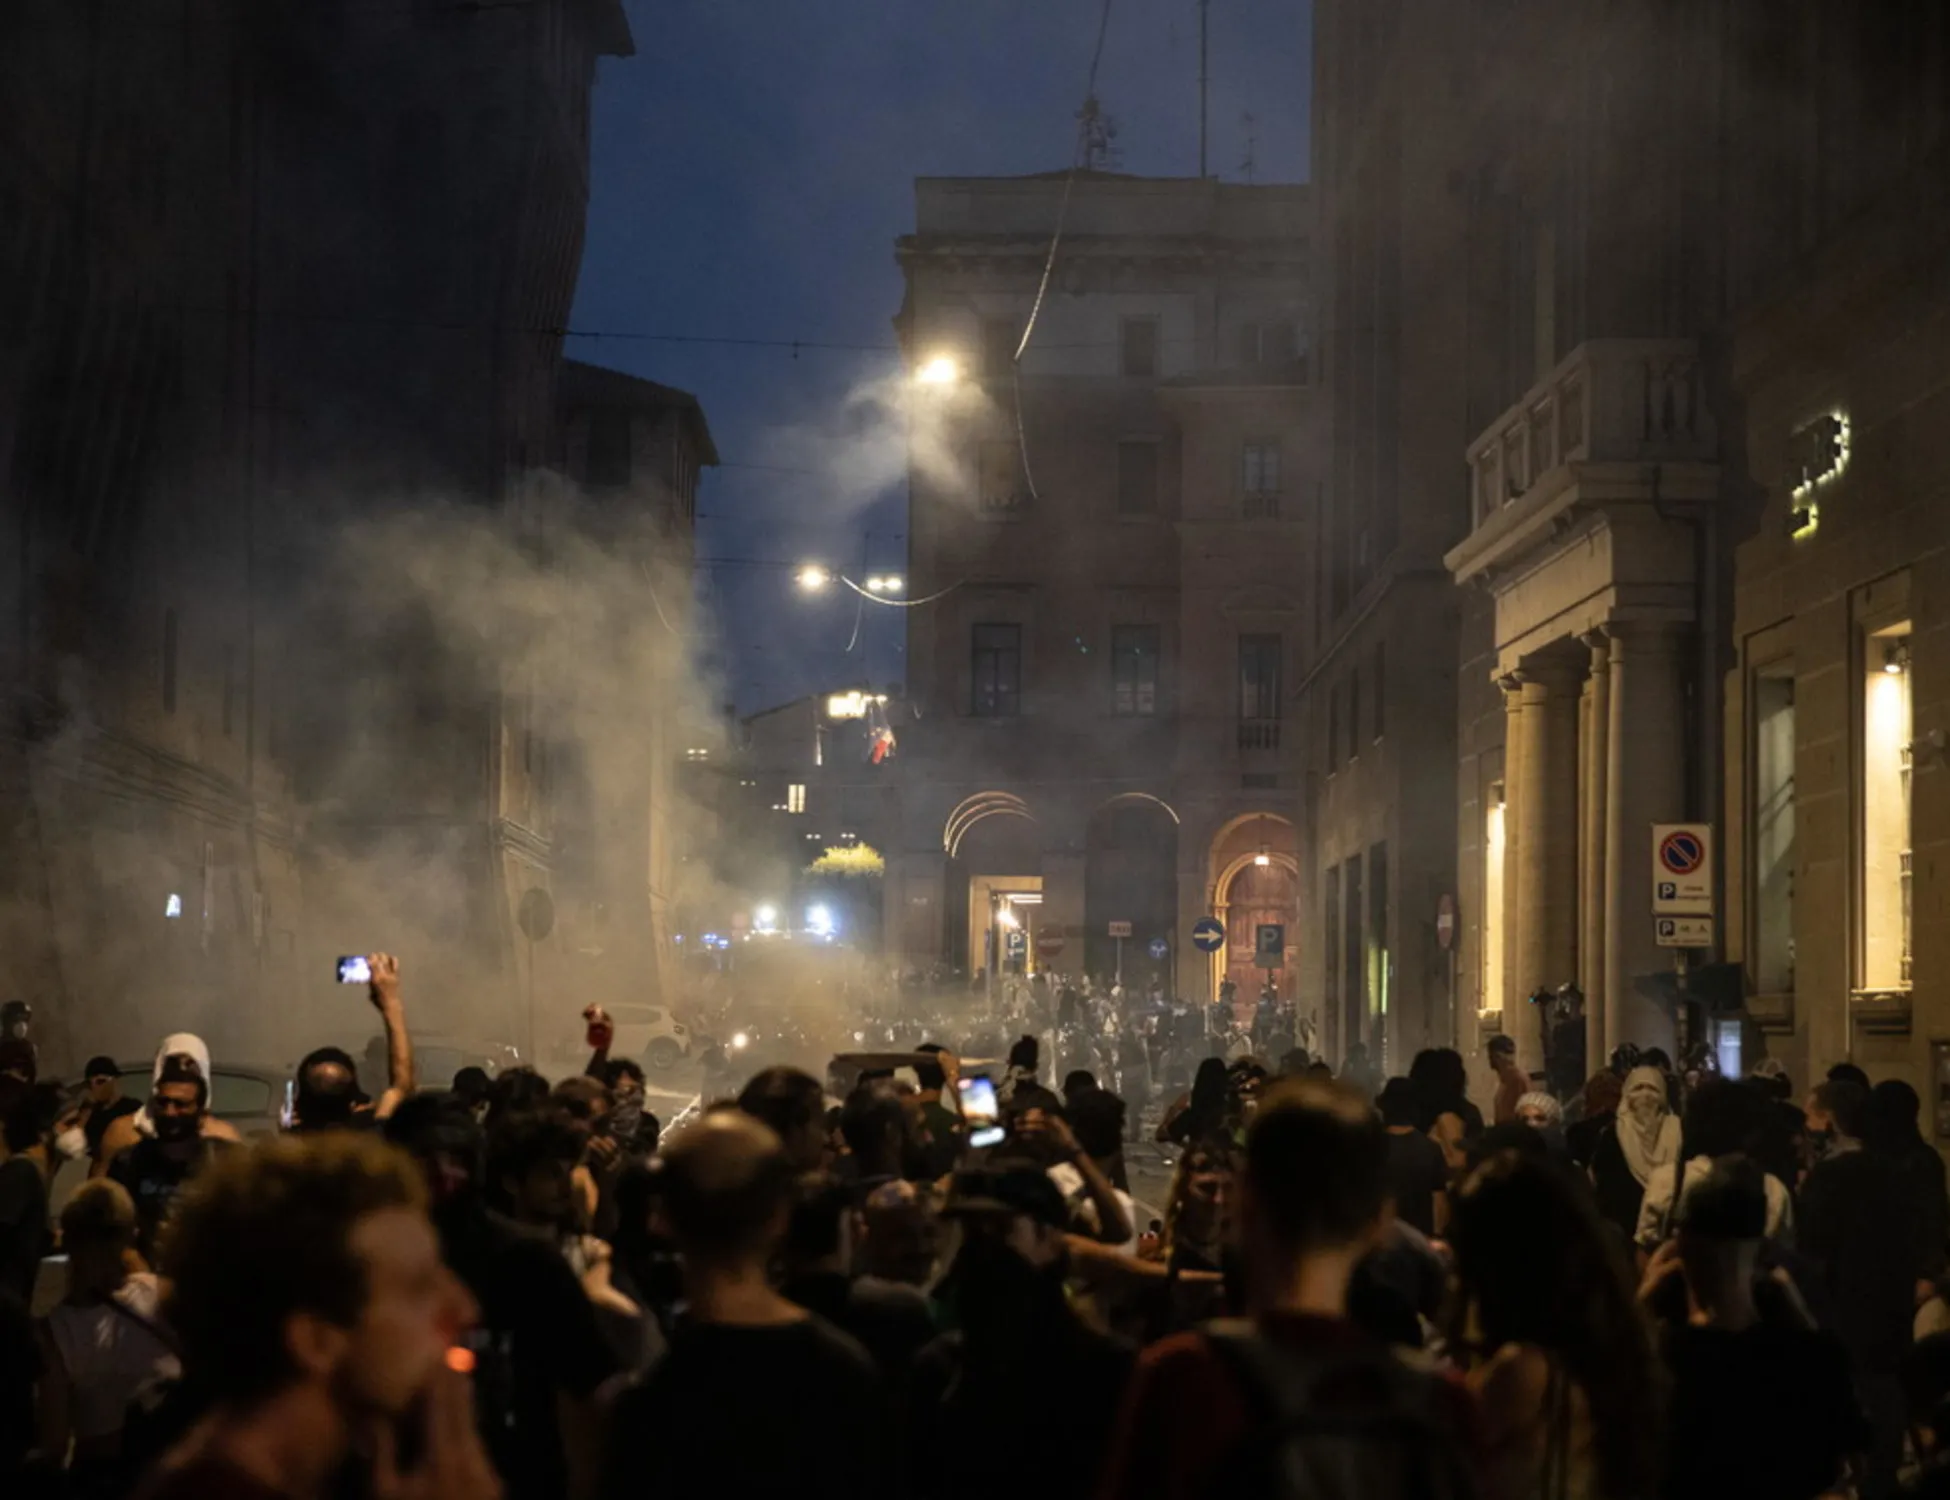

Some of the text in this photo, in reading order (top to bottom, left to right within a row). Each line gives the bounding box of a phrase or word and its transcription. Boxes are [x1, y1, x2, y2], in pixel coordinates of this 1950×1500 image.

[1662, 883, 1673, 899] P
[1662, 922, 1672, 936] P
[1010, 933, 1021, 947] P
[1260, 927, 1279, 951] P
